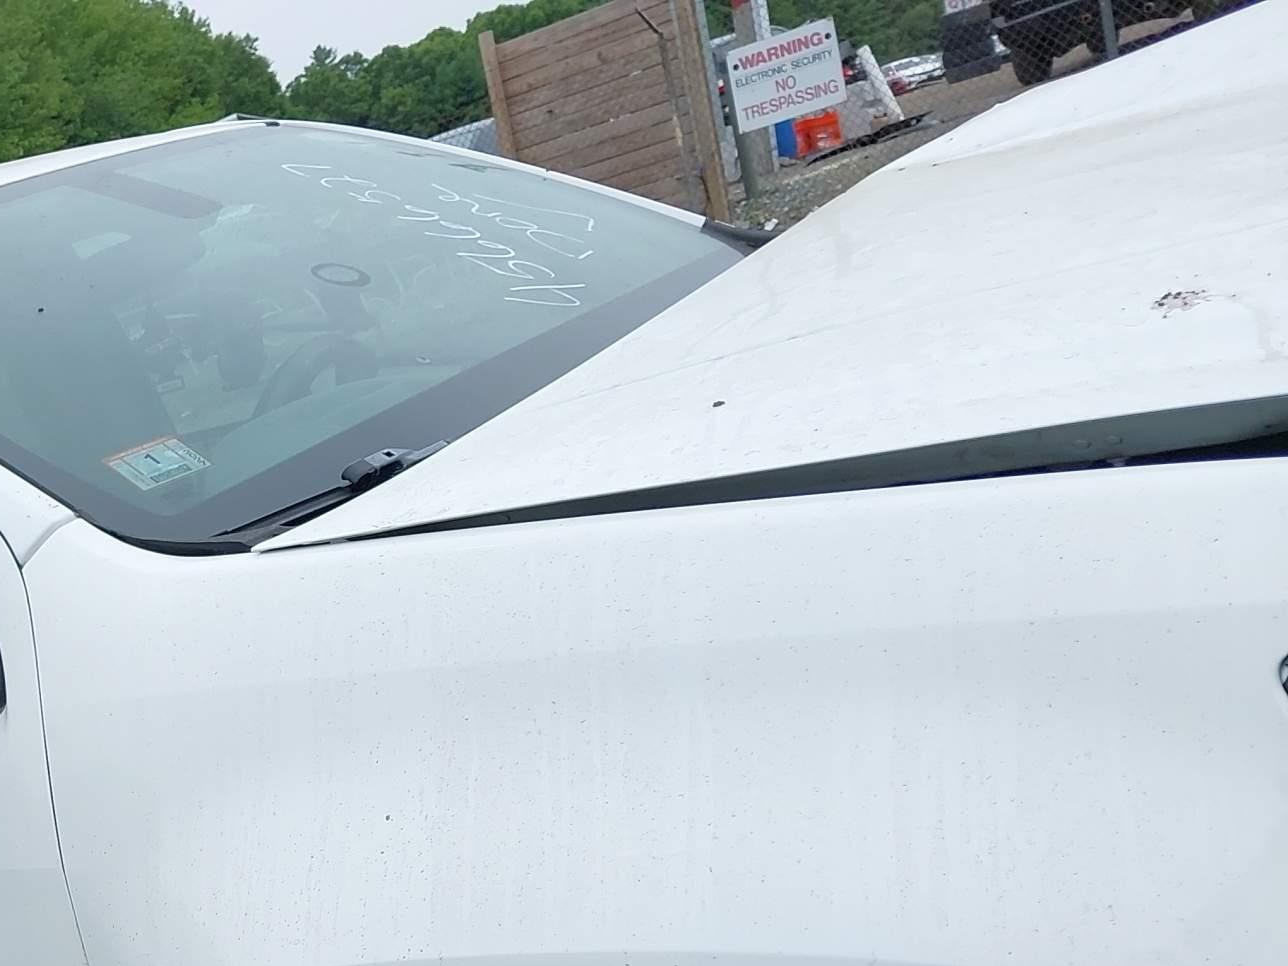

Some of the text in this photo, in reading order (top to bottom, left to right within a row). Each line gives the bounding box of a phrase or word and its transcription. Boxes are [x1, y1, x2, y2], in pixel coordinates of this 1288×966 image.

[735, 50, 833, 88] ELECTRONIC SECURITY
[738, 32, 824, 70] WARNING
[742, 79, 840, 121] TRESPASSING
[775, 75, 797, 93] NO
[143, 453, 161, 465] 1
